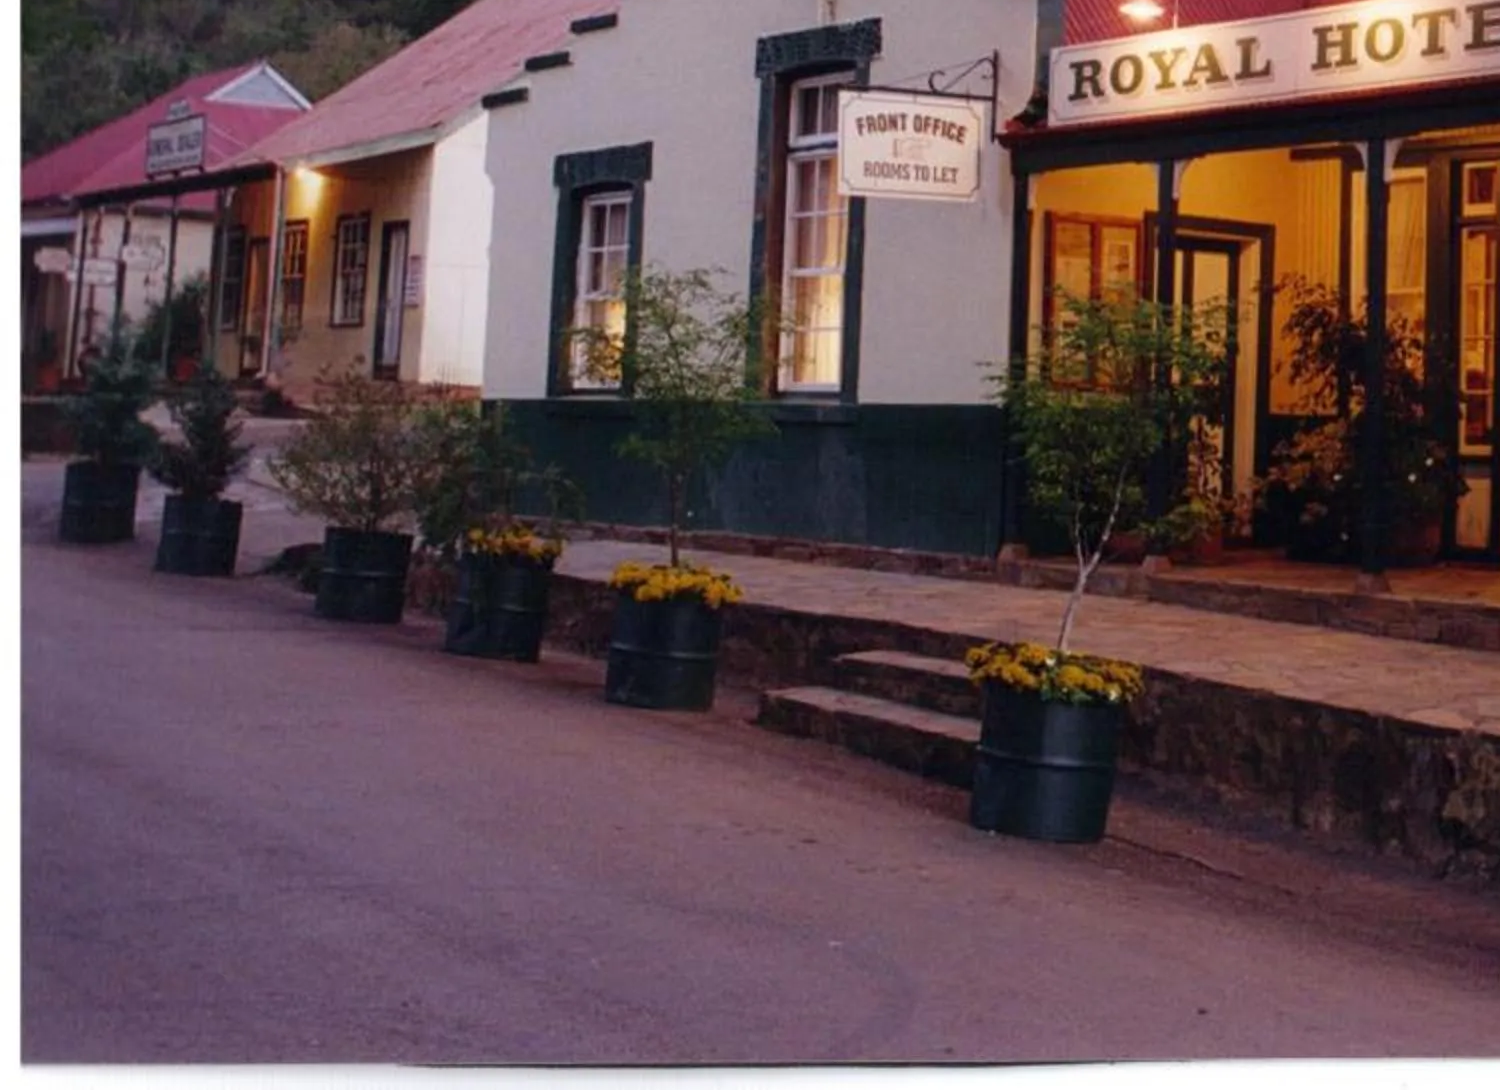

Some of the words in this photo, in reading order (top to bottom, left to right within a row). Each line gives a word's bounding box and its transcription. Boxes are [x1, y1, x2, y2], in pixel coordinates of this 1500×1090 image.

[1067, 37, 1273, 101] ROYAL
[855, 113, 908, 136] FRONT
[913, 114, 967, 143] OFFICE
[863, 161, 910, 181] ROOMS
[914, 164, 930, 182] TO
[933, 166, 959, 184] LET
